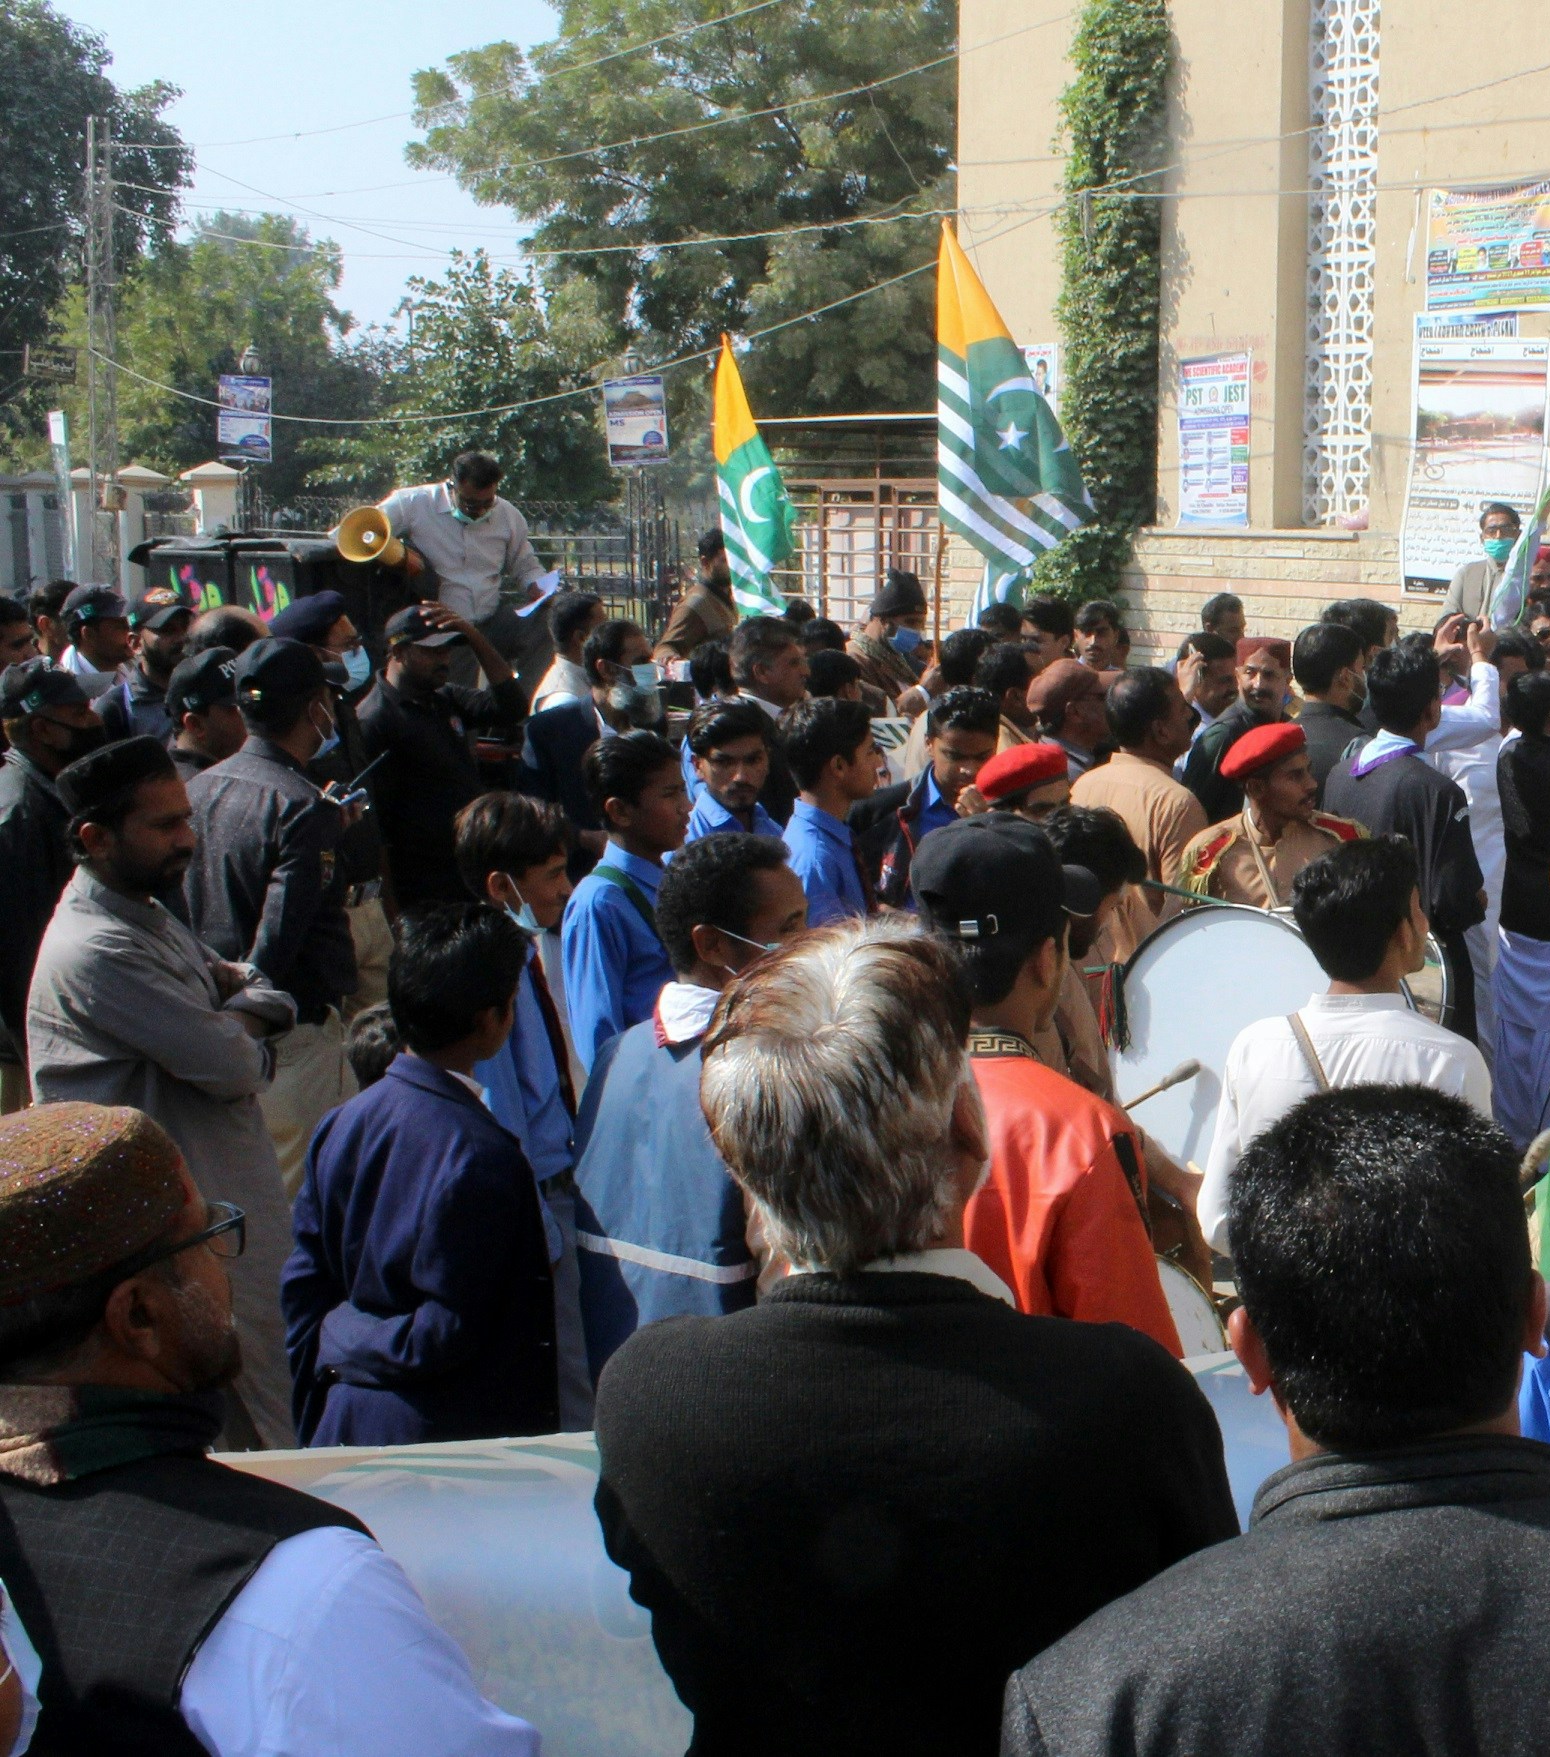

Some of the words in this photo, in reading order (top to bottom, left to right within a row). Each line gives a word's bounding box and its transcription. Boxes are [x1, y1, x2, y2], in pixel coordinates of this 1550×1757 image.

[1193, 364, 1221, 377] SCIENTIFIC
[1222, 361, 1248, 374] ACADEMY
[1185, 387, 1203, 406] PST
[1224, 384, 1246, 403] JEST
[609, 418, 625, 426] MS
